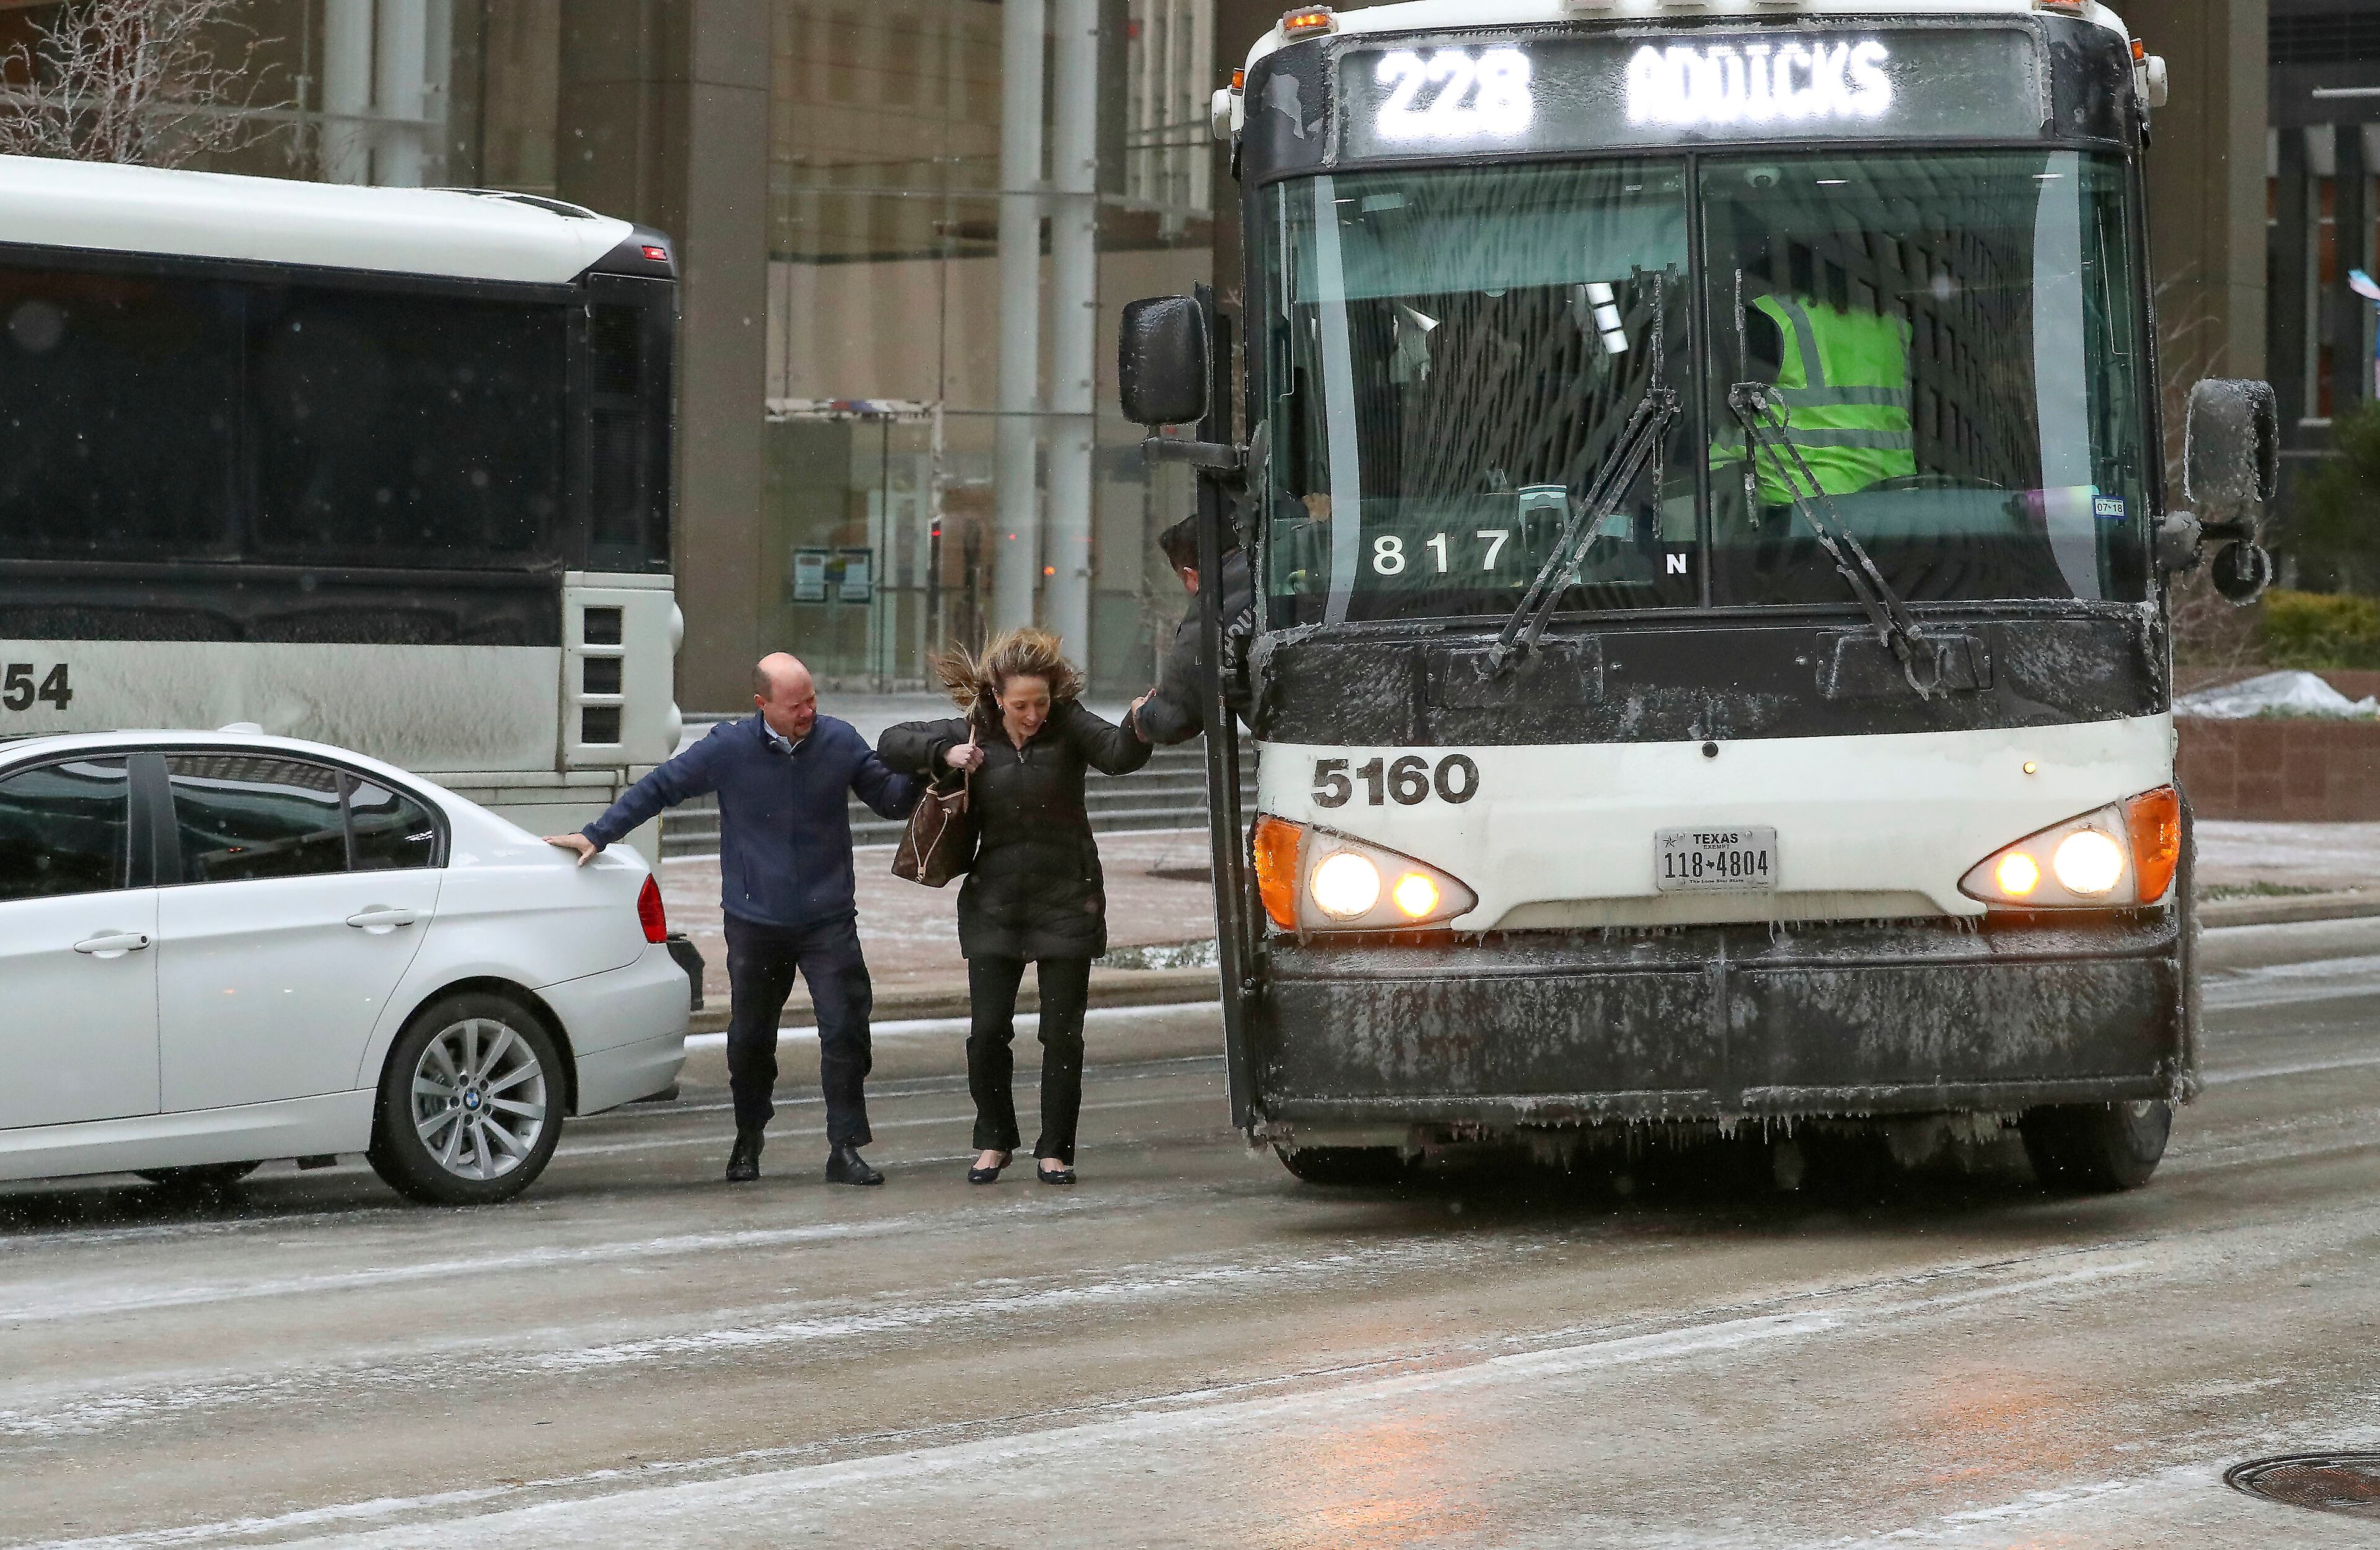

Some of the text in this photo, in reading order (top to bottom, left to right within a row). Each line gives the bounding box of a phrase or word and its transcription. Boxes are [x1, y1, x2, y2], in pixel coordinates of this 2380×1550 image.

[1377, 50, 1531, 136] 228
[1666, 553, 1687, 575] N
[0, 663, 73, 711] 54
[1311, 754, 1479, 808] 5160
[1693, 833, 1739, 845] TEXAS
